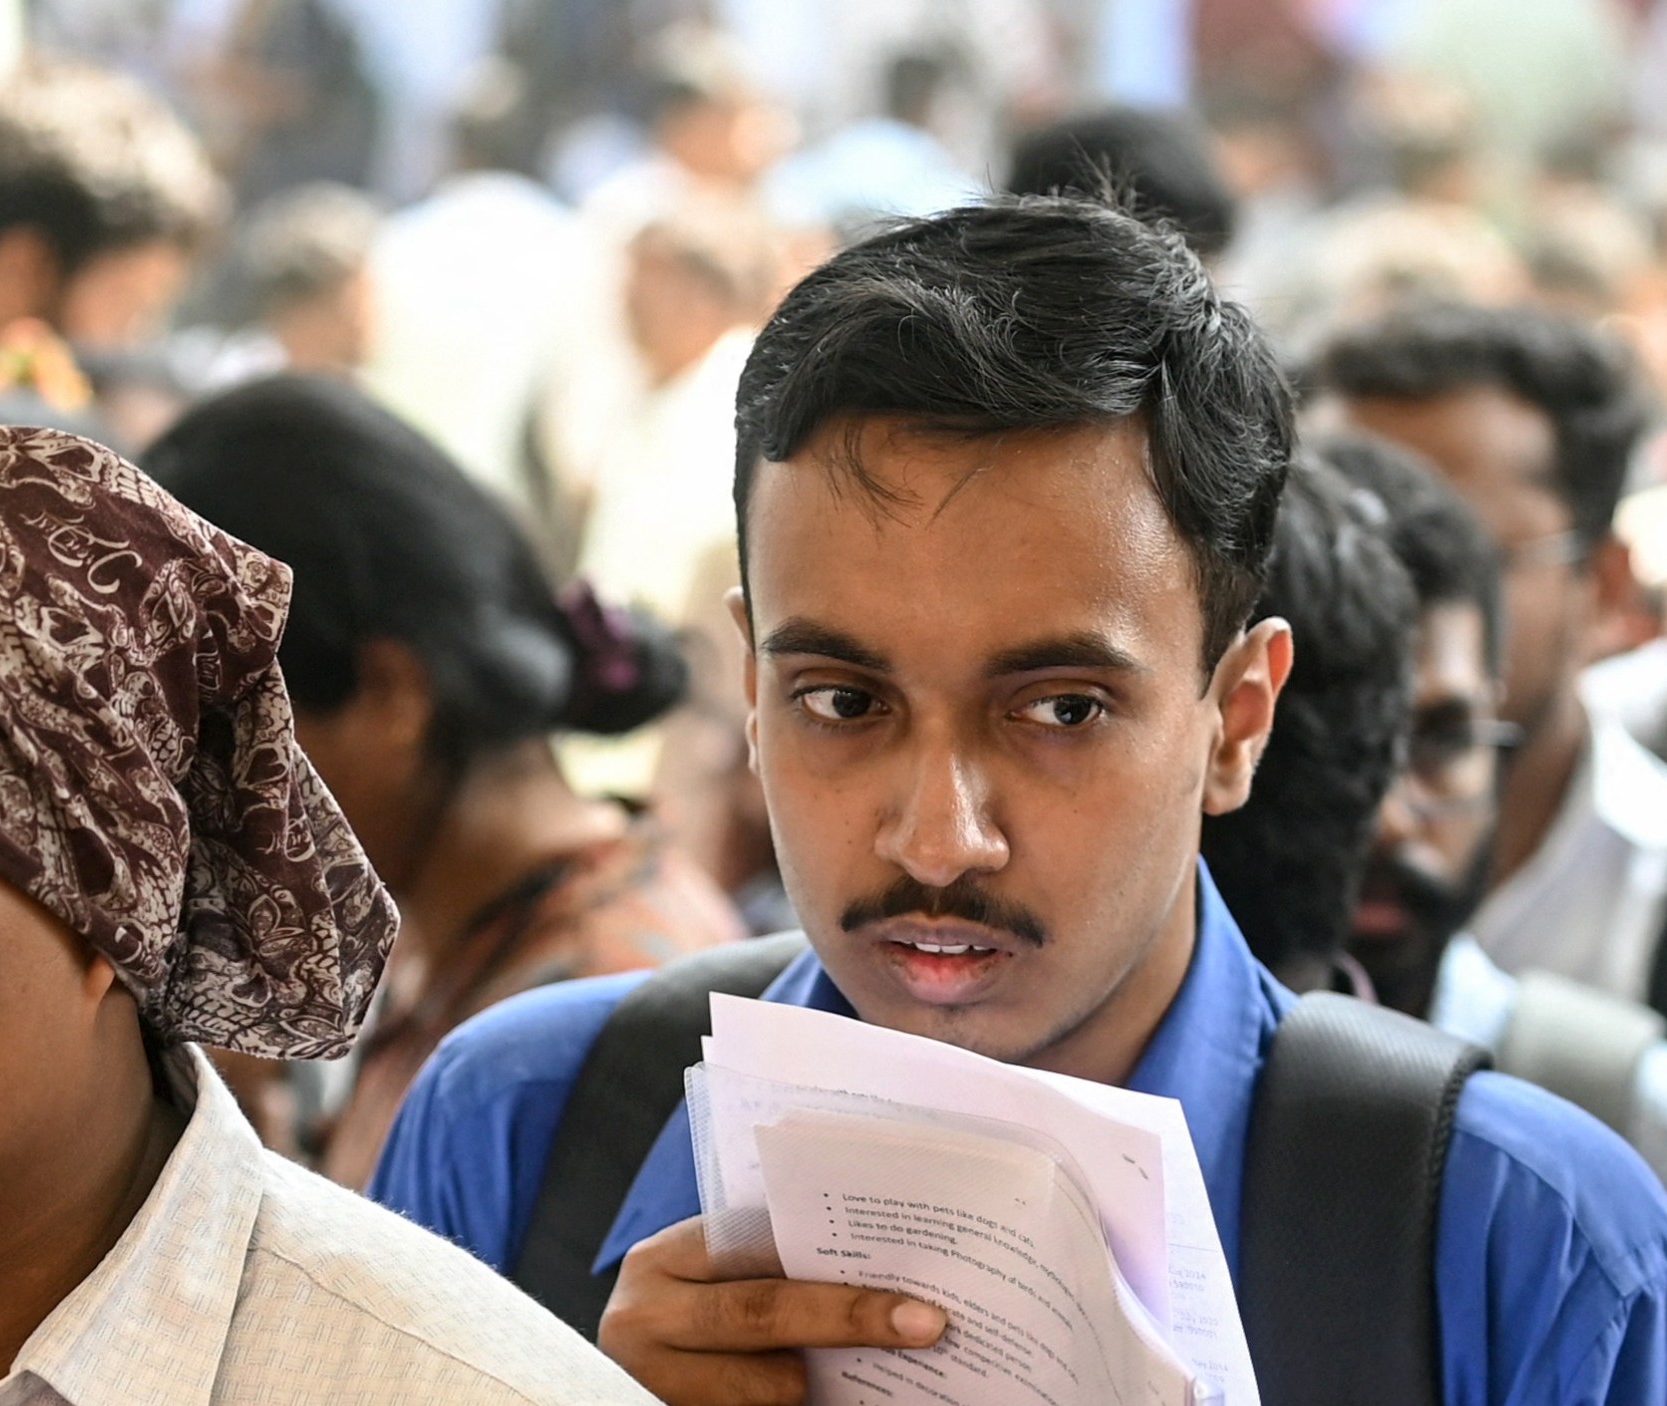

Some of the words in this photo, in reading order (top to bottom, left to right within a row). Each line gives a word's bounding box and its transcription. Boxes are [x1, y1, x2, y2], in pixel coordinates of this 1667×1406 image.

[842, 1193, 867, 1202] Love
[869, 1196, 881, 1204] to
[883, 1198, 904, 1208] play
[906, 1201, 930, 1211] with
[932, 1205, 954, 1216] pets
[956, 1209, 974, 1221] like
[976, 1215, 999, 1229] dogs
[1000, 1225, 1016, 1238] and
[844, 1207, 900, 1219] Interested
[901, 1212, 912, 1220] in
[913, 1214, 956, 1231] learning
[956, 1224, 992, 1242] general
[848, 1220, 874, 1229] Likes
[876, 1223, 888, 1231] to
[890, 1224, 904, 1233] do
[906, 1228, 958, 1245] gardening.
[816, 1247, 839, 1256] Soft
[840, 1250, 872, 1260] Skills:
[850, 1233, 904, 1245] Interested
[906, 1239, 916, 1247] in
[918, 1242, 949, 1257] taking
[950, 1249, 1006, 1281] Photography
[858, 1270, 901, 1283] Friendly
[902, 1276, 940, 1295] towards
[964, 1299, 989, 1317] elders
[991, 1312, 1007, 1326] and
[1008, 1321, 1024, 1337] pets
[967, 1316, 983, 1330] and
[963, 1330, 1004, 1356] dedicated
[905, 1377, 914, 1386] in
